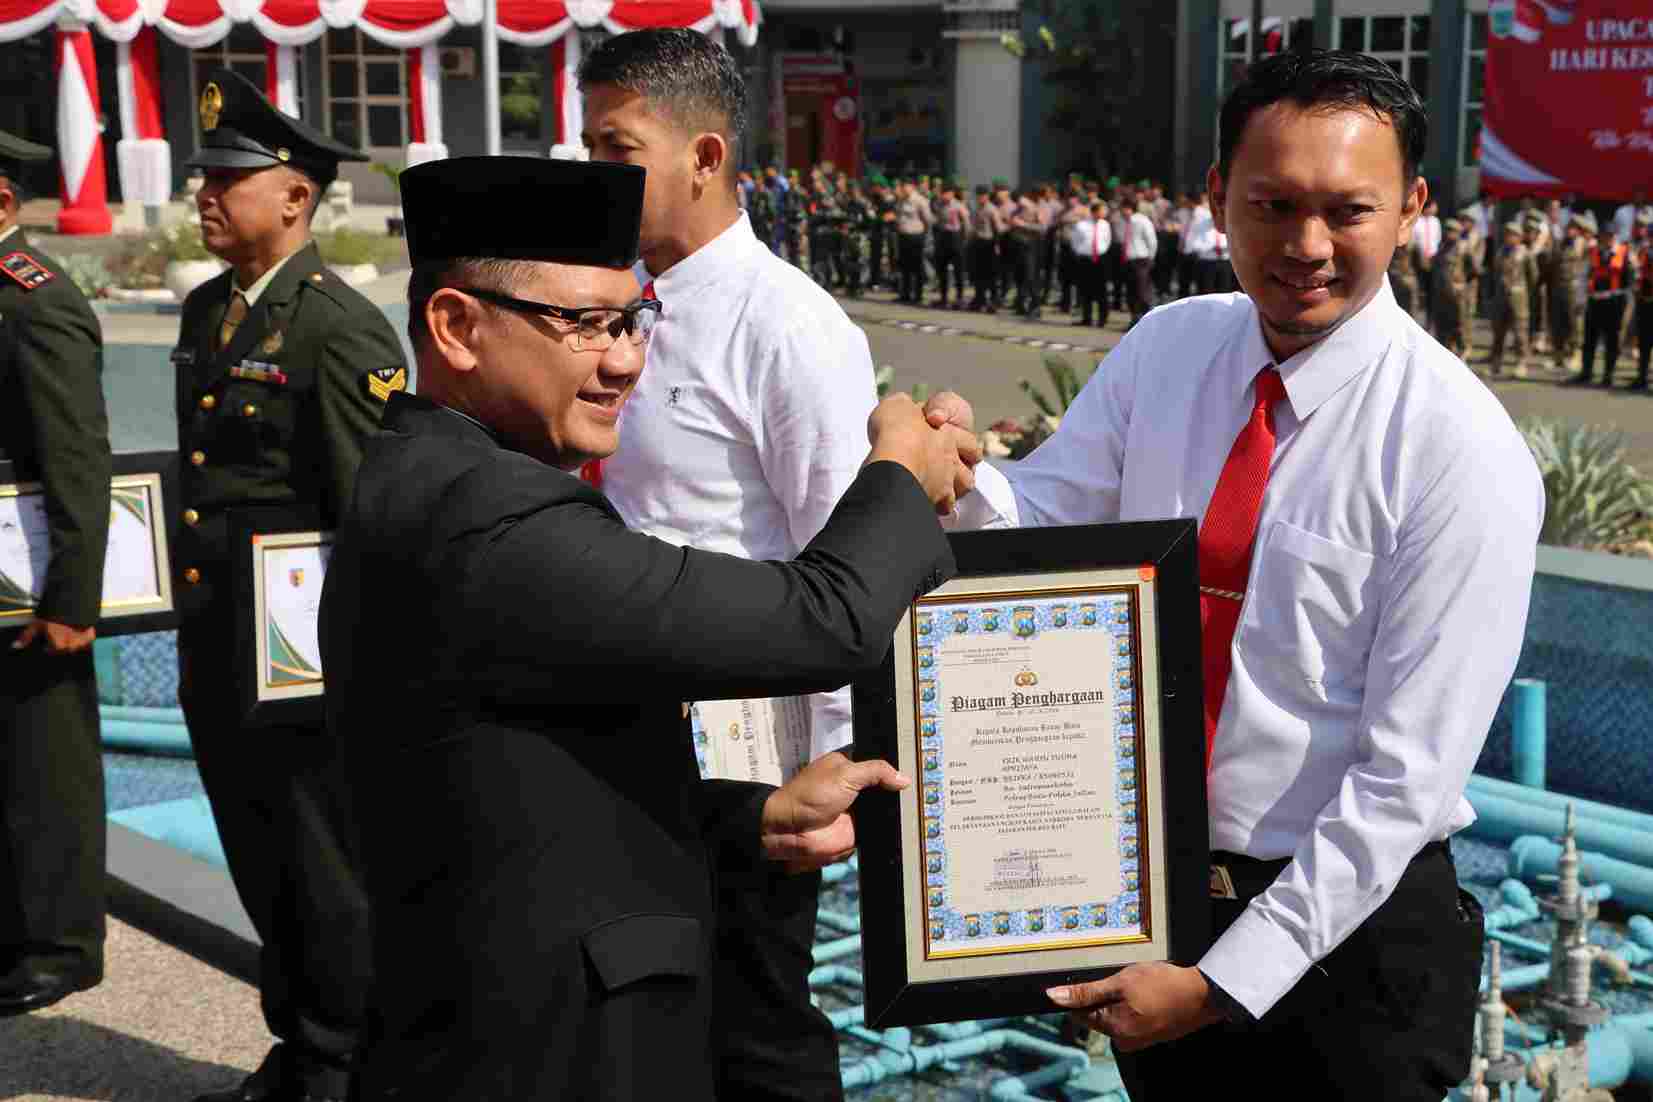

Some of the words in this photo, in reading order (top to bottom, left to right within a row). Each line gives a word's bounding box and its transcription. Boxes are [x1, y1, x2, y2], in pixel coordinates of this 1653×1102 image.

[1551, 49, 1606, 70] HARI
[951, 694, 1006, 712] Piagam
[1011, 689, 1103, 708] Penghargaan
